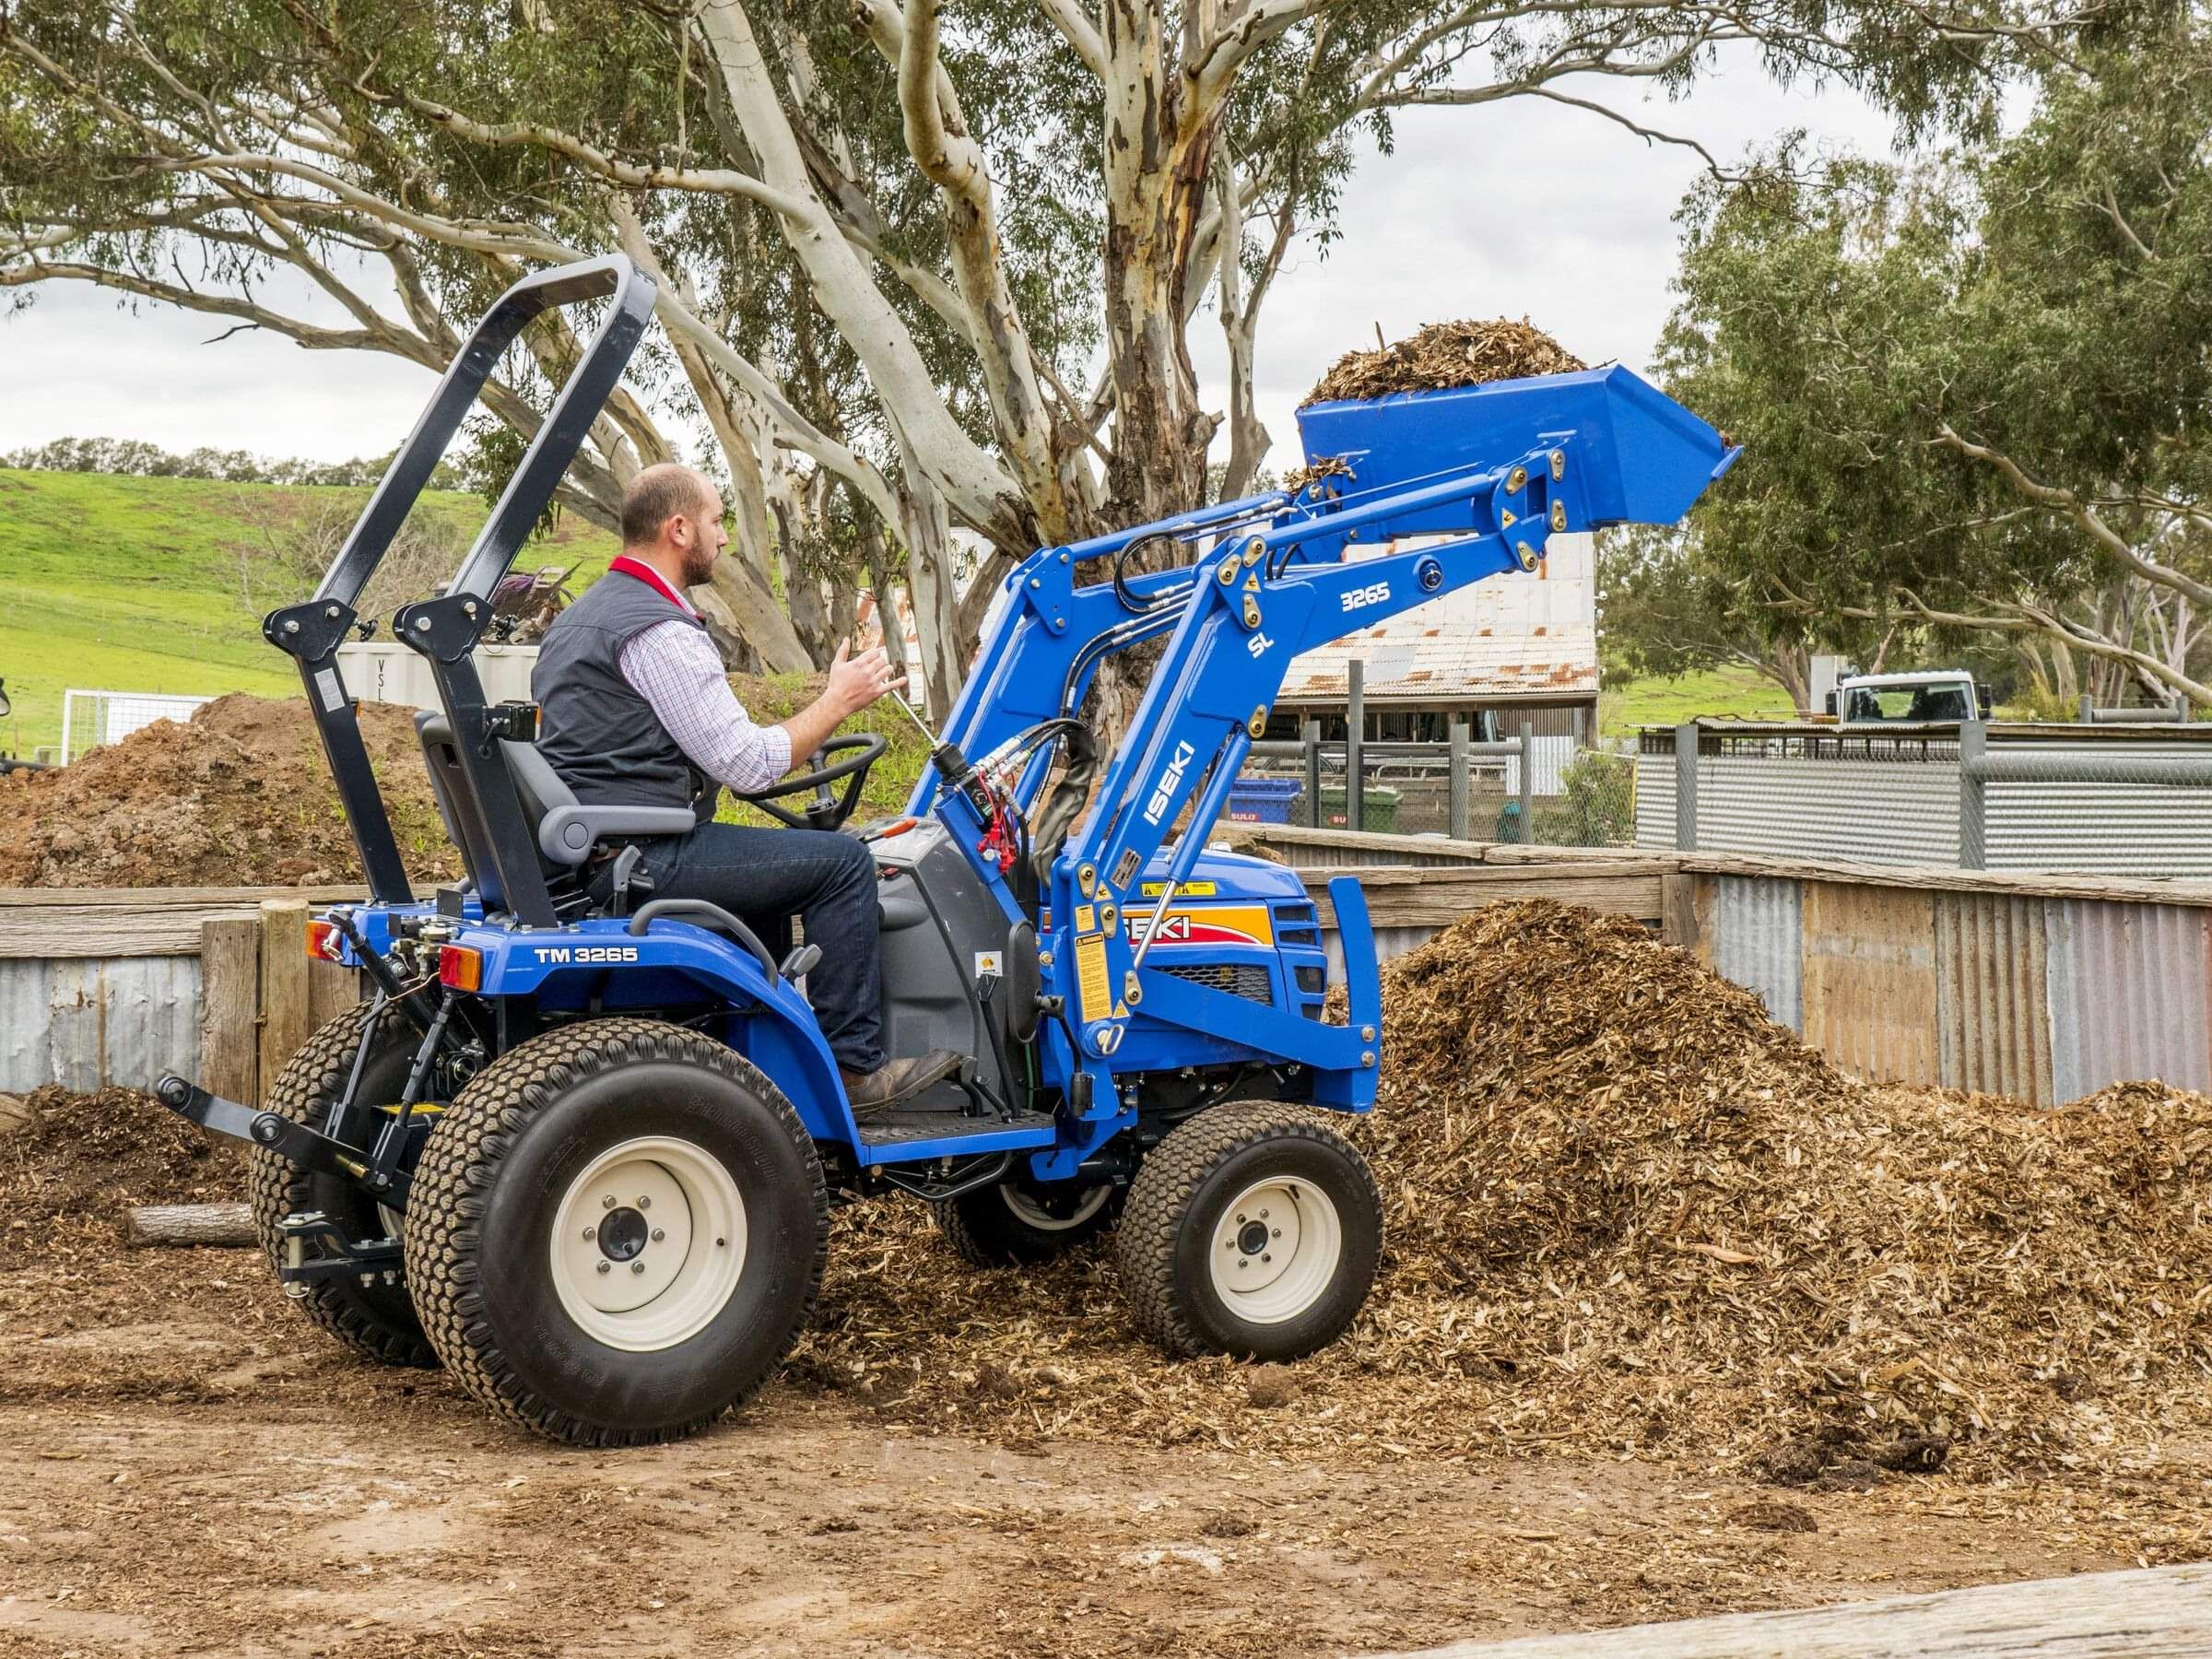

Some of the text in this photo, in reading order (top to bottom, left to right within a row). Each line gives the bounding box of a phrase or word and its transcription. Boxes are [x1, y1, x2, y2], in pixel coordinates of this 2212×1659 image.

[1340, 582, 1390, 612] 3265
[1247, 632, 1275, 659] SL
[1143, 740, 1195, 827] ISEKI
[1334, 816, 1347, 824] SU
[1123, 915, 1191, 940] EKI
[534, 947, 638, 963] TM 3265
